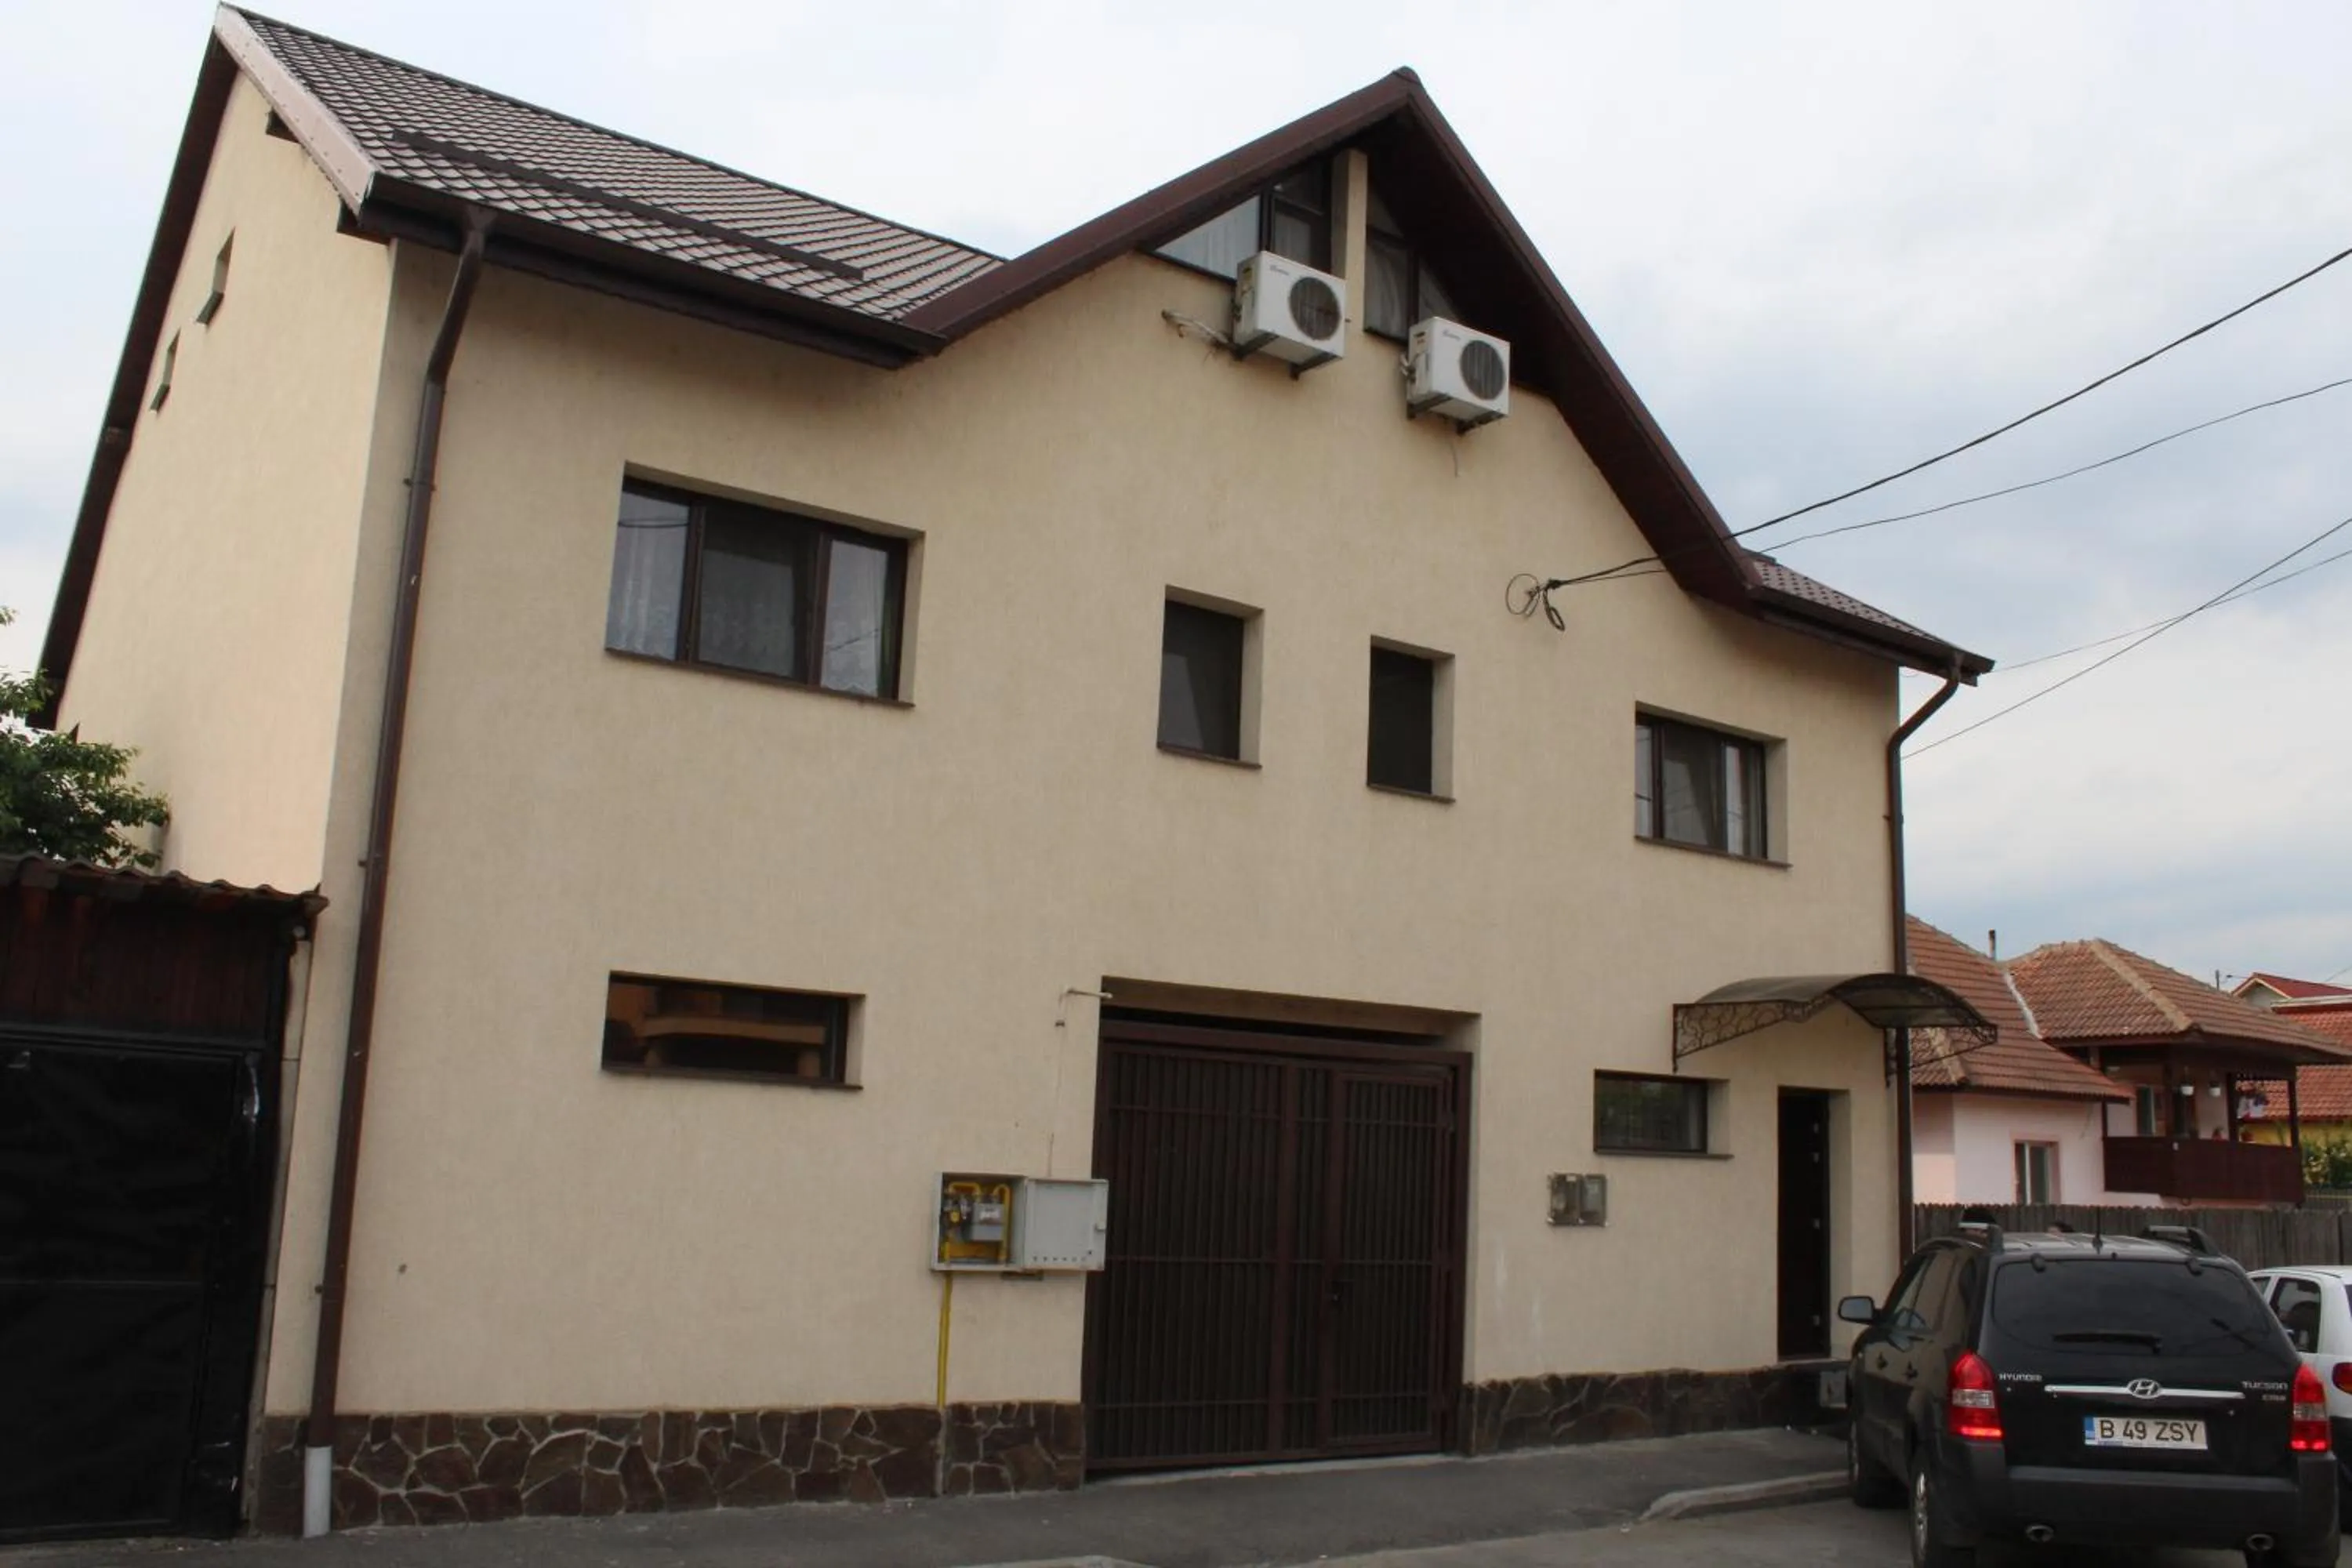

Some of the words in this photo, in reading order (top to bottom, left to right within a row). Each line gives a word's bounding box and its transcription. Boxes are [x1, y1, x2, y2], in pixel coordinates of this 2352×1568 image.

[2242, 1381, 2288, 1390] TUCSON
[2100, 1420, 2114, 1439] B
[2122, 1420, 2147, 1440] 49
[2154, 1421, 2198, 1443] ZSY
